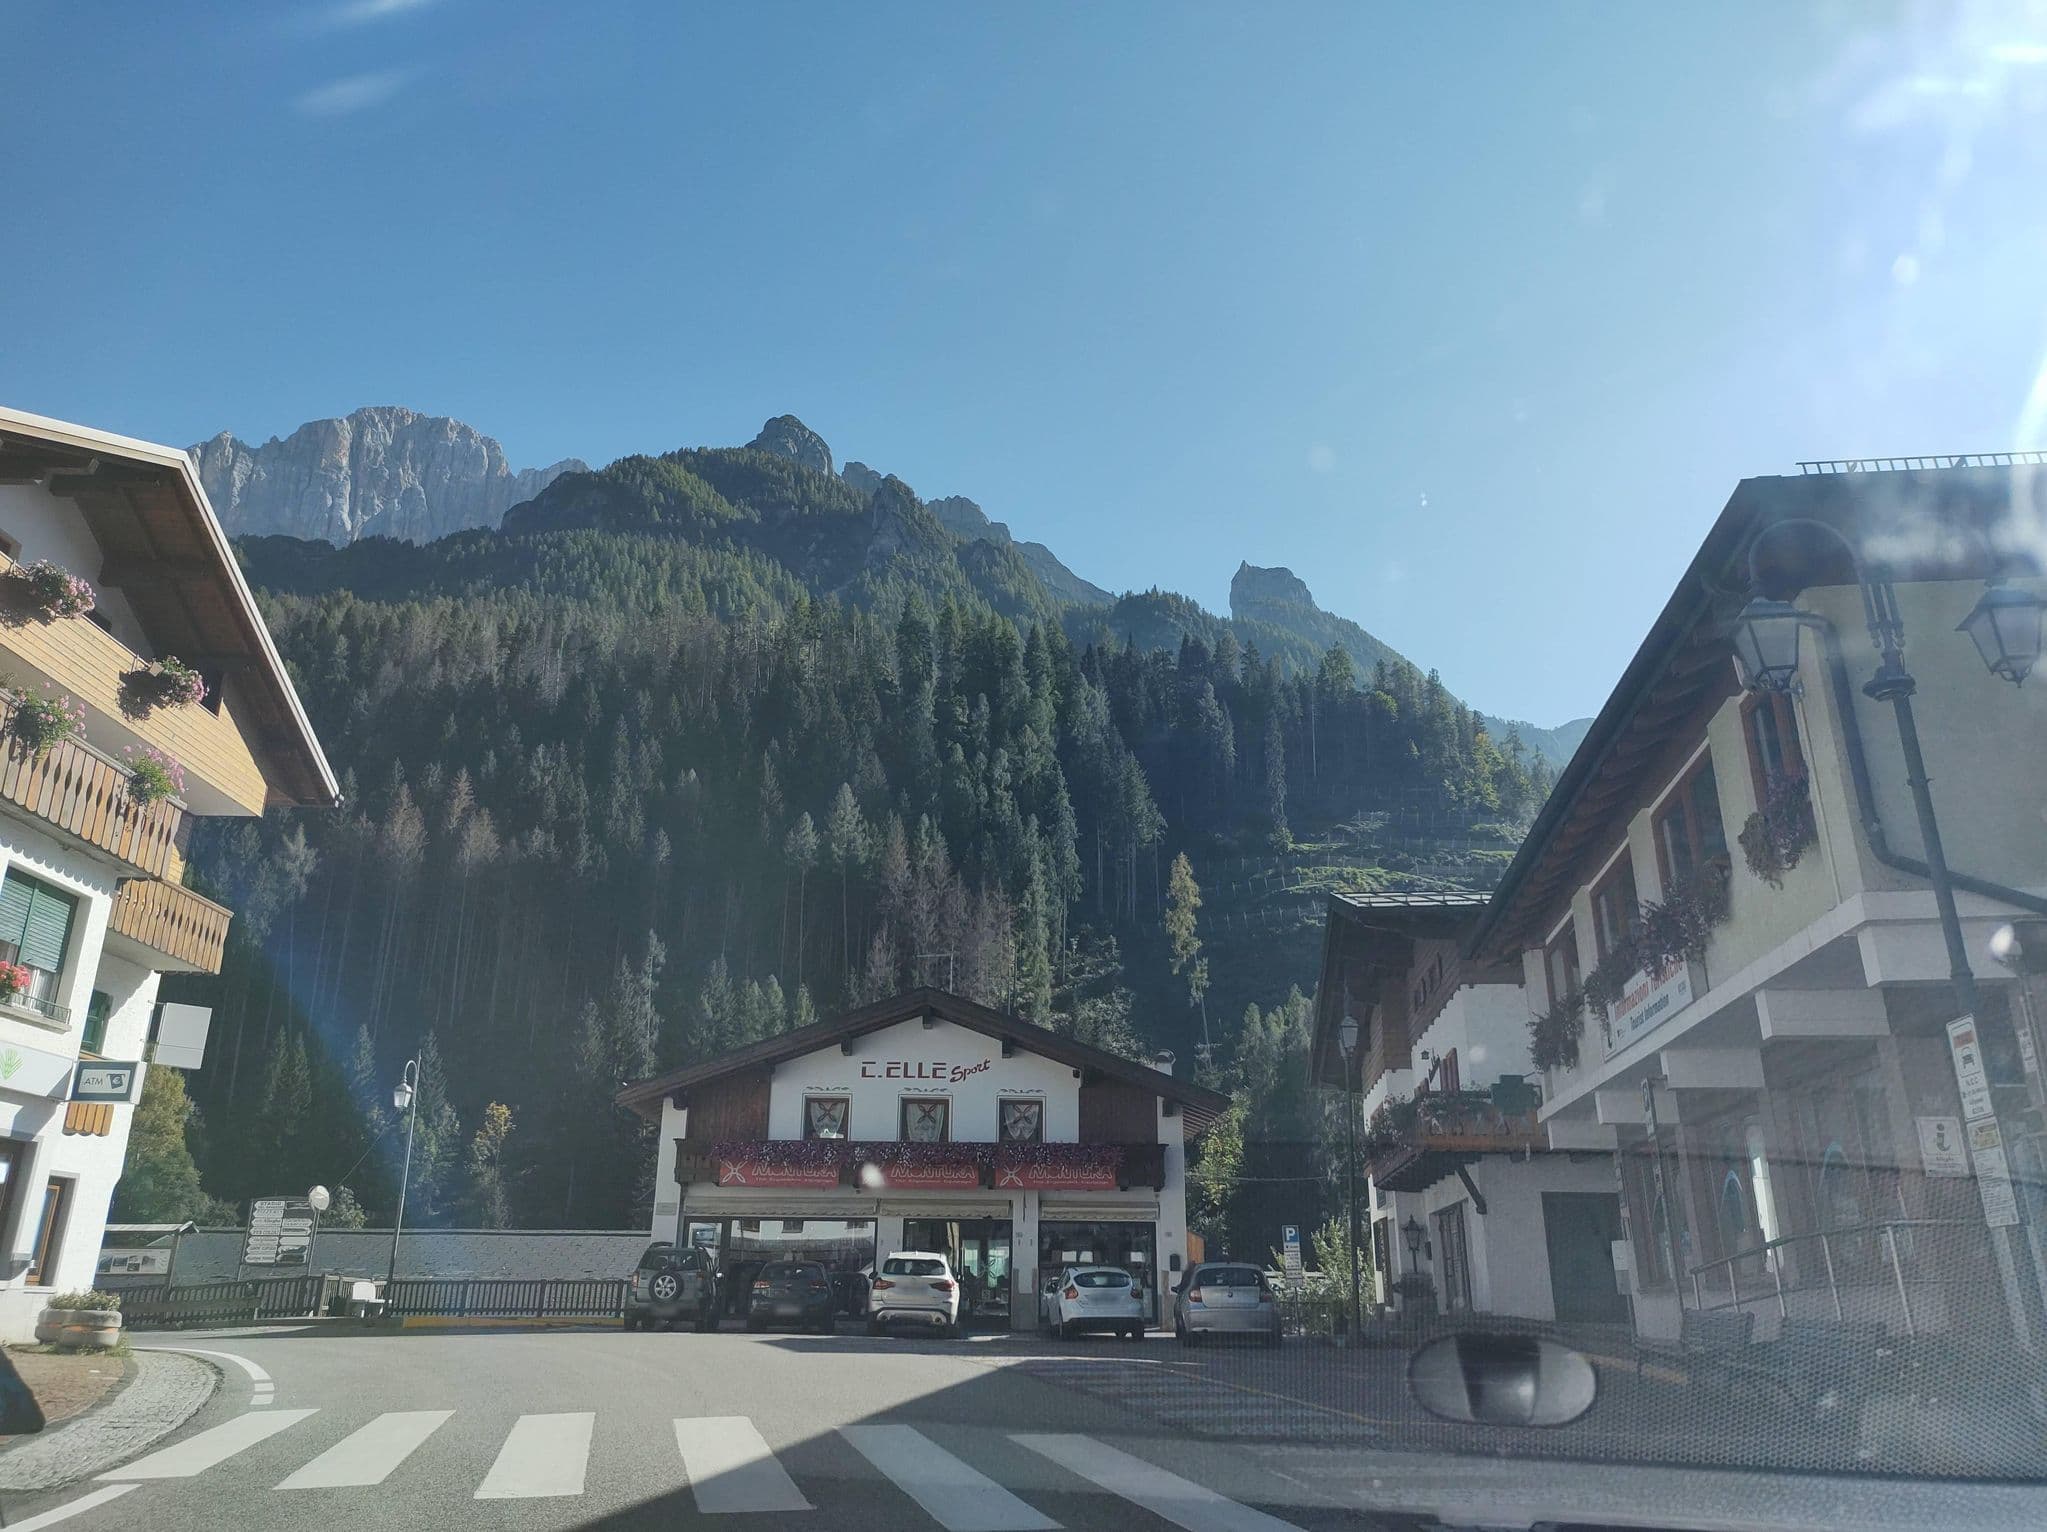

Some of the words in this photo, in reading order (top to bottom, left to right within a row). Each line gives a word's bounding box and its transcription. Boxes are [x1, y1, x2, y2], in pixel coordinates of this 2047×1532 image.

[1630, 1010, 1644, 1030] Tourist
[1644, 994, 1670, 1021] Information
[861, 1061, 947, 1079] C.ELLE
[949, 1058, 991, 1083] Sport
[84, 1077, 103, 1086] ATM
[890, 1163, 976, 1179] MONTURA
[1285, 1227, 1296, 1241] P
